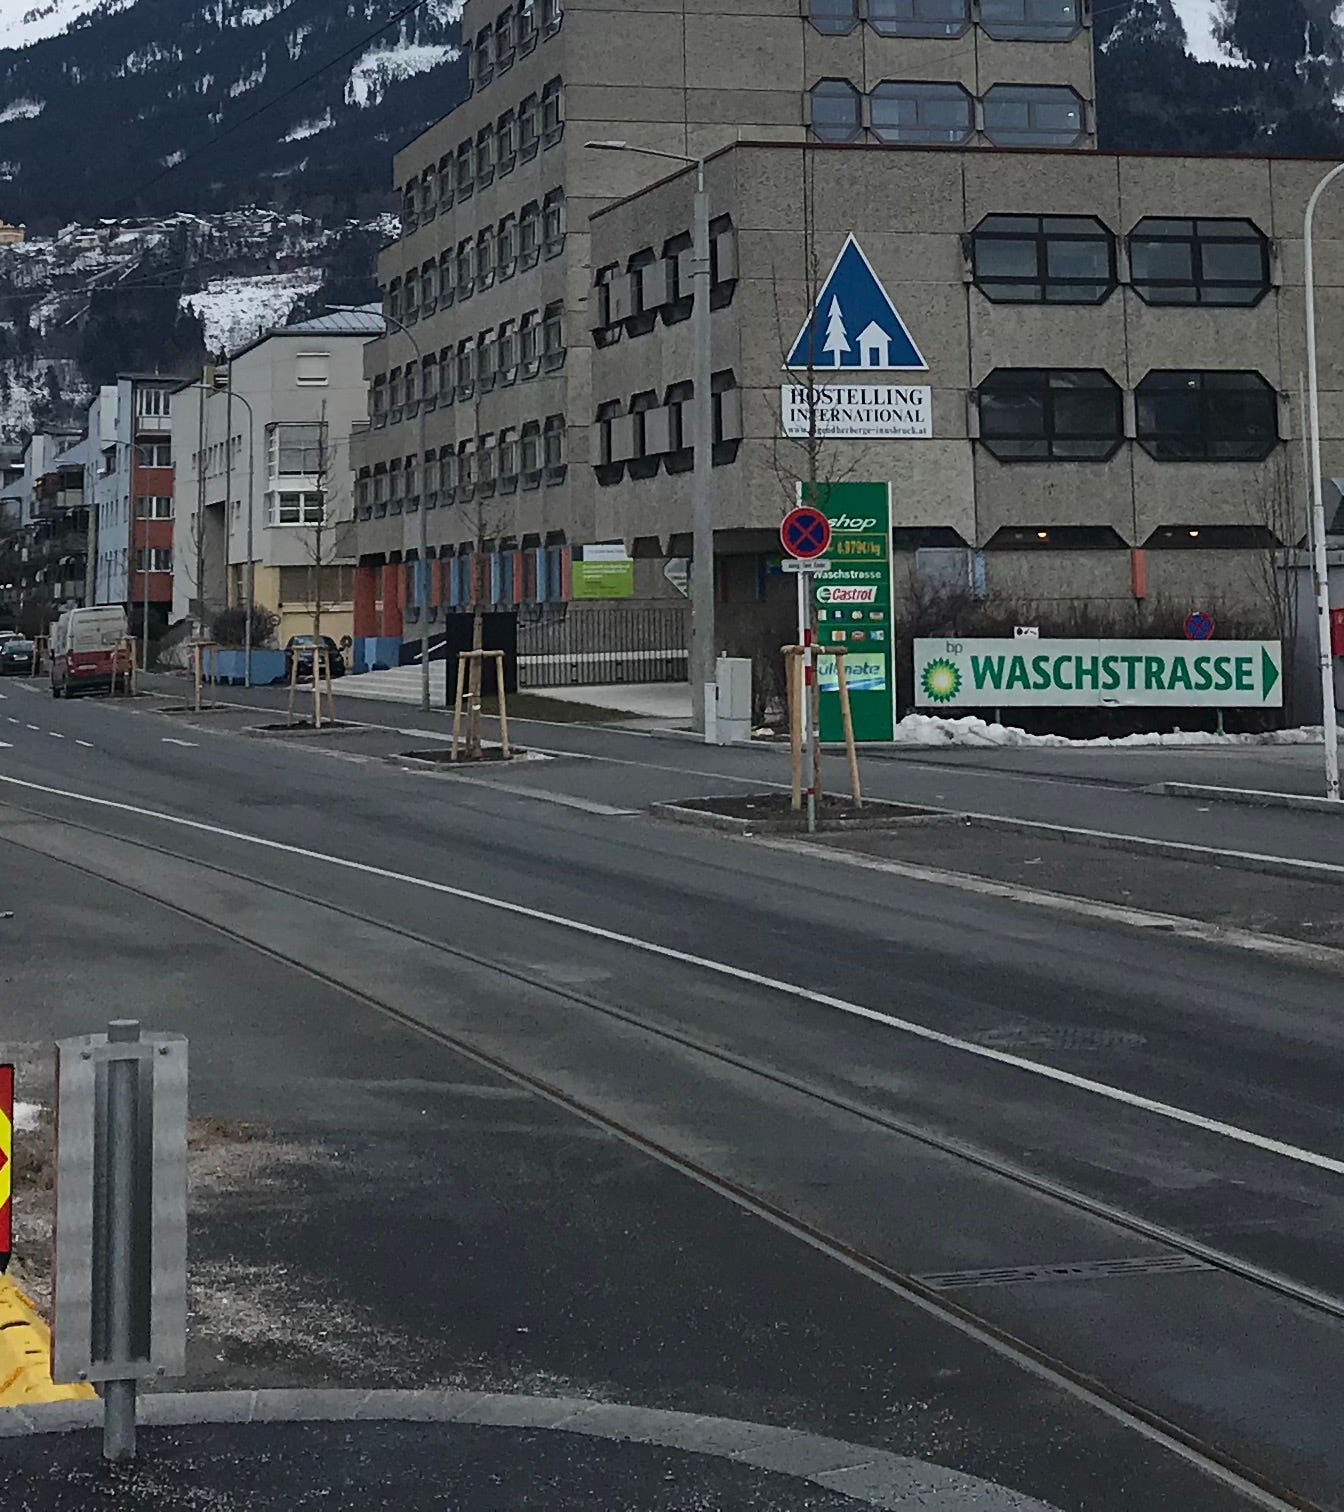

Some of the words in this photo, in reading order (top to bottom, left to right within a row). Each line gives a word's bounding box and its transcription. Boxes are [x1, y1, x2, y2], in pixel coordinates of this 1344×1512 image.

[790, 388, 923, 406] HOSTELLING
[828, 514, 877, 529] shop
[832, 587, 873, 601] Castrol
[946, 640, 964, 656] bp
[818, 662, 881, 676] ulmate
[970, 654, 1255, 692] WASCHSTRASSE
